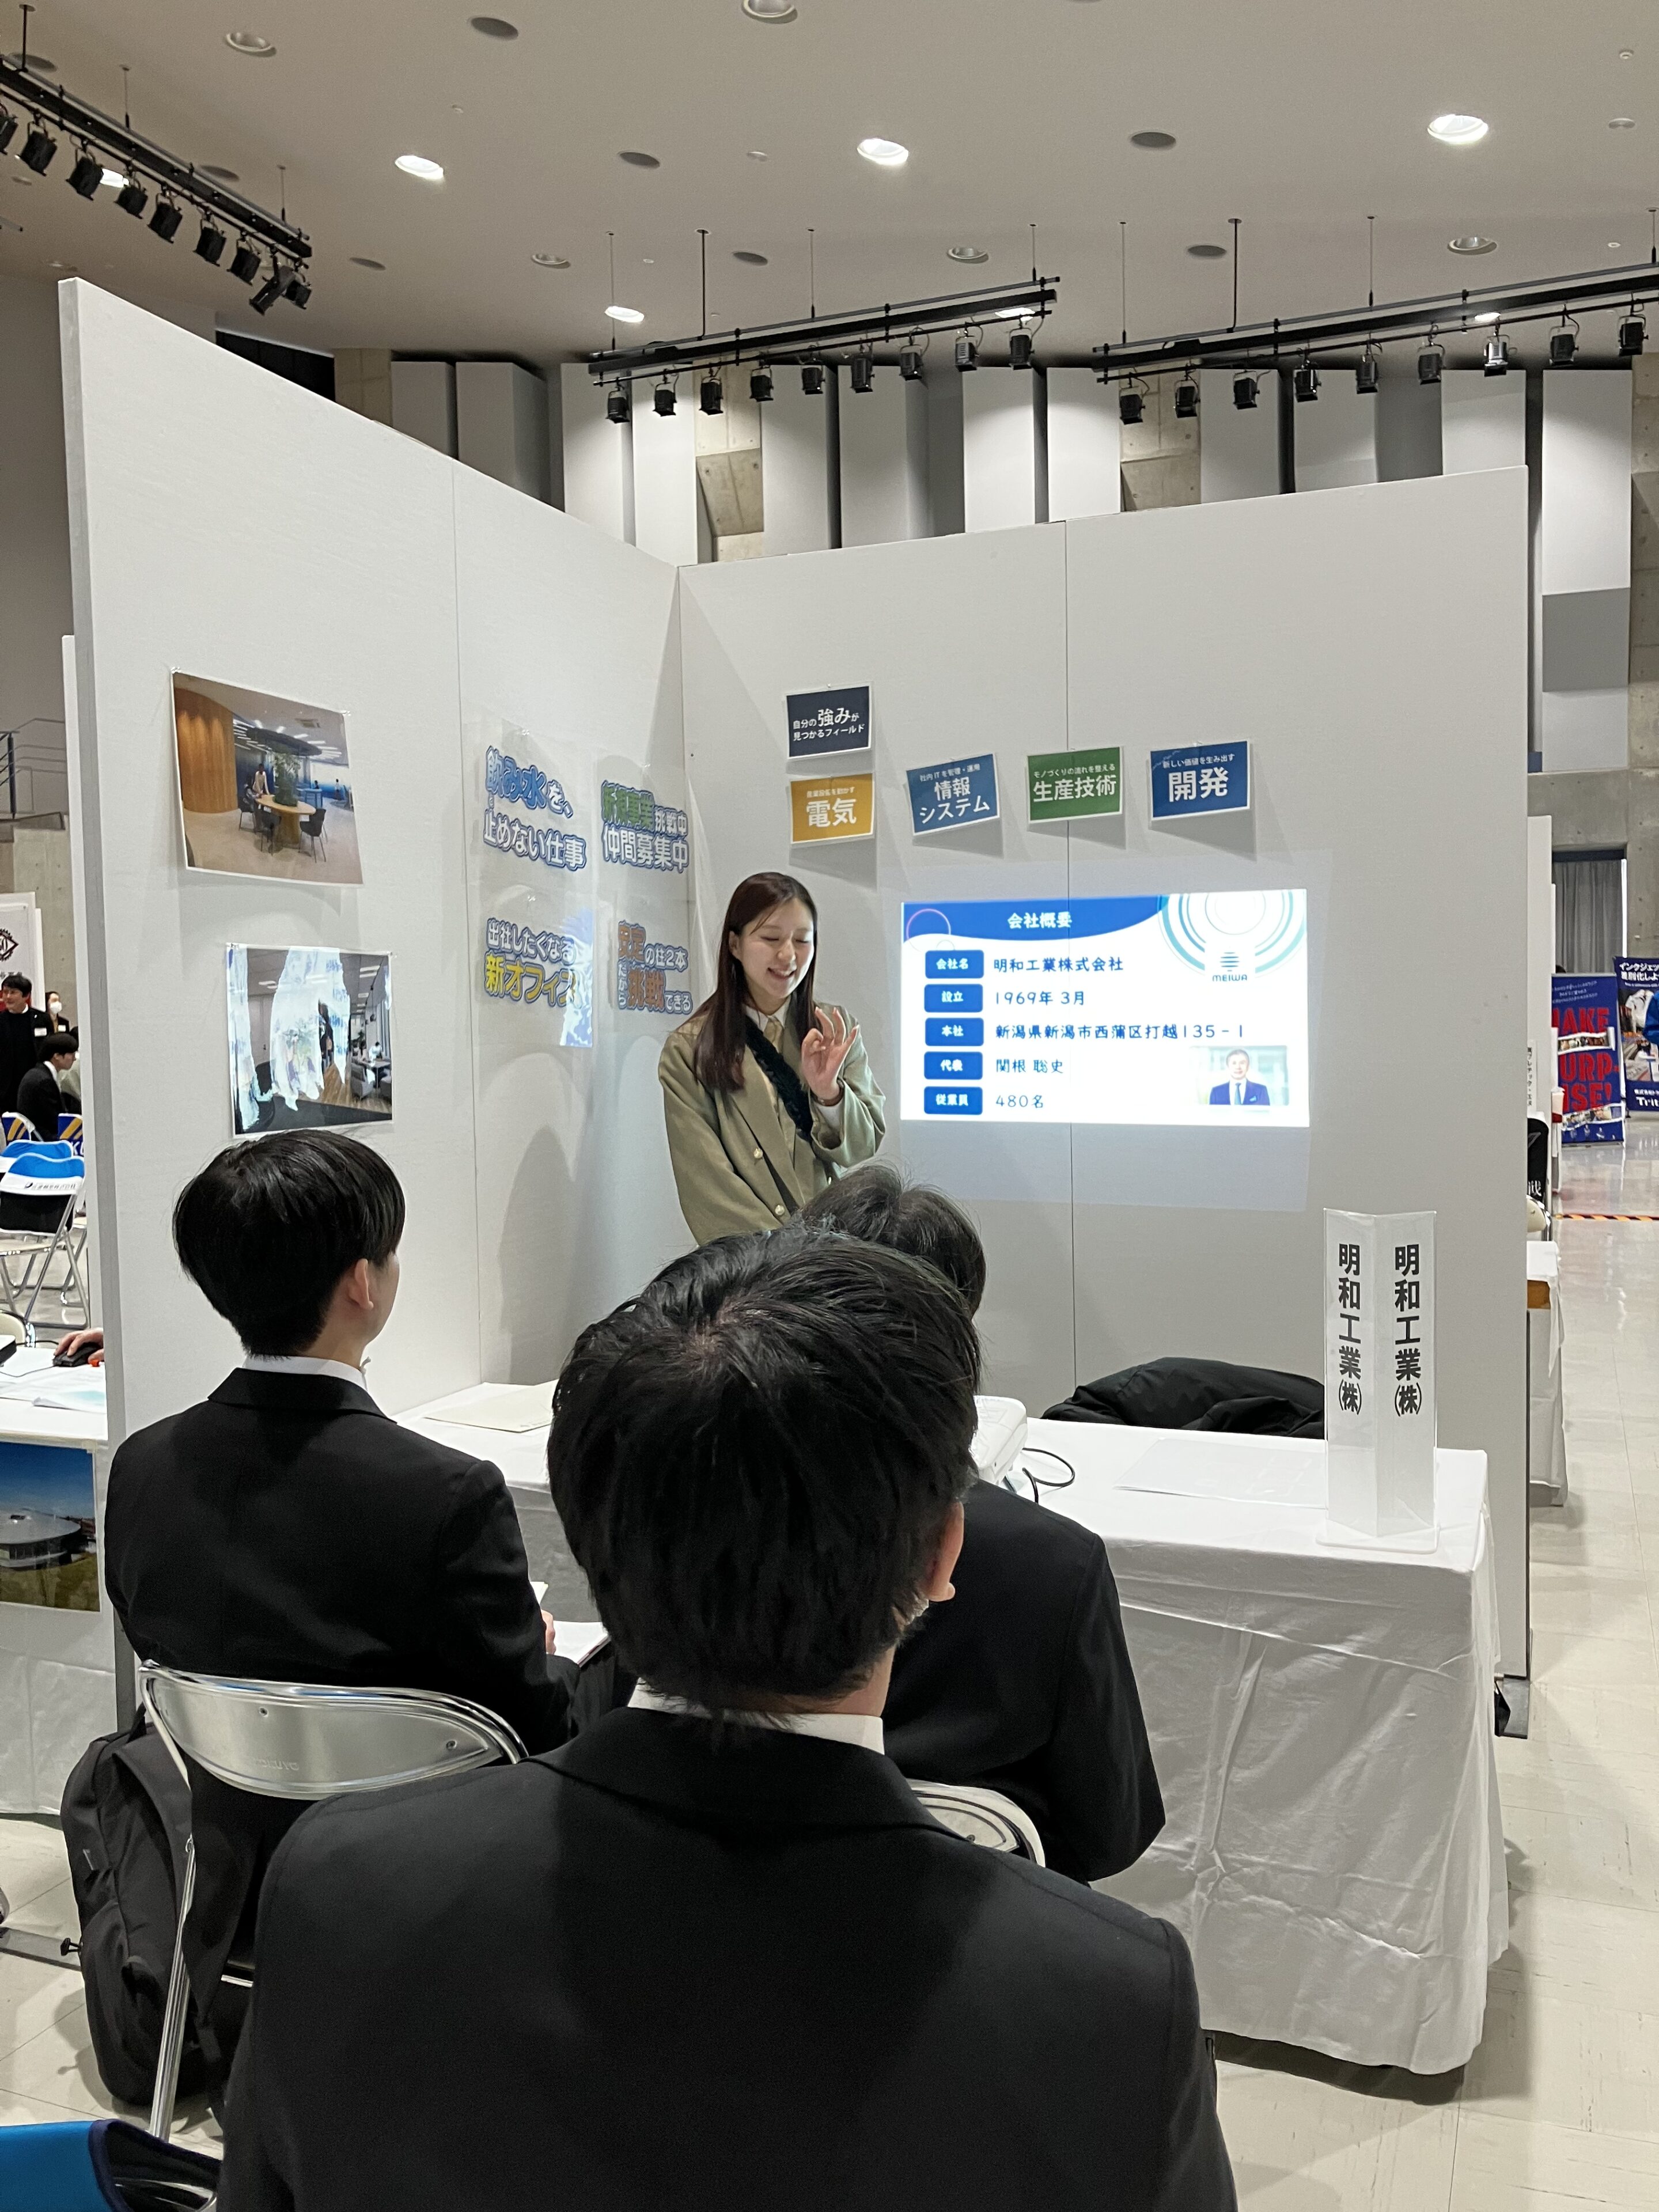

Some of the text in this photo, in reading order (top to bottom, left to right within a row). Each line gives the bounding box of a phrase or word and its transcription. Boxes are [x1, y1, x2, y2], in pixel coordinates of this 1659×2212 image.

[793, 707, 859, 729] 自分の強みが
[793, 724, 865, 741] 見つかるフィールド
[934, 777, 971, 801] 情報
[1033, 774, 1117, 802] 生産技術
[1168, 767, 1229, 802] 開発
[806, 798, 857, 827] 電気
[919, 795, 990, 824] システム
[483, 808, 586, 871] 止めない仕事
[601, 822, 690, 874] 仲間募集中
[1007, 911, 1073, 929] 会社概要
[487, 917, 575, 966] 出社したくなる
[935, 957, 969, 970] 会社名
[993, 956, 1124, 973] 明和工業株式会社
[1213, 974, 1248, 982] MEIWA
[941, 990, 964, 1003] 設立
[995, 991, 1085, 1005] 1969年 3月
[941, 1024, 964, 1037] 本社
[1552, 1007, 1609, 1036] AKE
[1559, 1052, 1620, 1082] URP-
[995, 1094, 1044, 1108] 480名
[1563, 1082, 1612, 1112] ISE!
